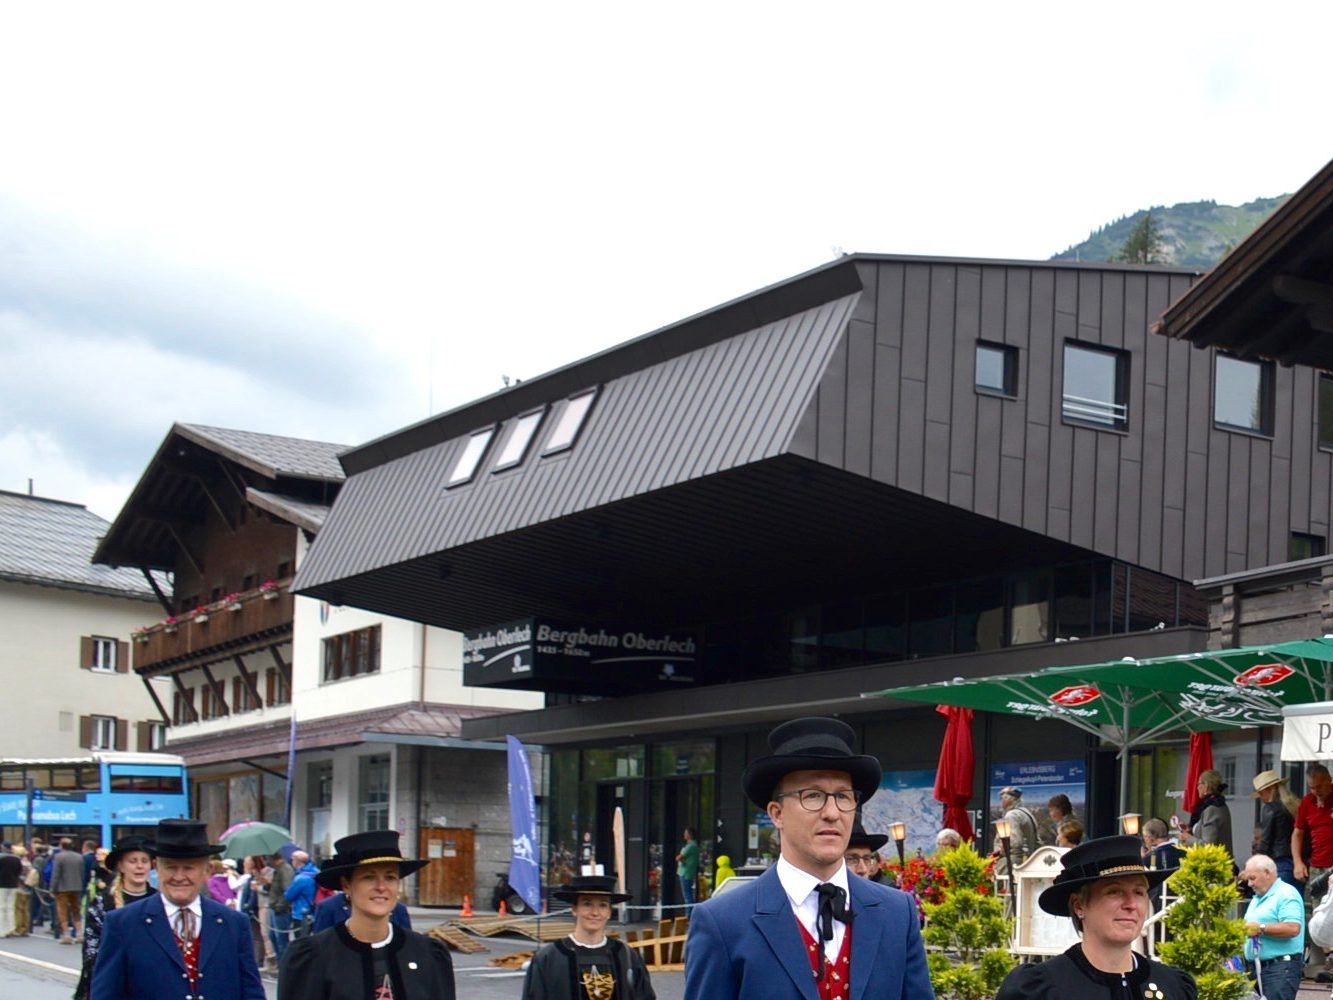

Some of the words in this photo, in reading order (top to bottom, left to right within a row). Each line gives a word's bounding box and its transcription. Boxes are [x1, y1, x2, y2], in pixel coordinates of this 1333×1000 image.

[496, 624, 531, 646] Oberlech
[536, 624, 618, 648] Bergbahn
[622, 632, 696, 654] Oberlech
